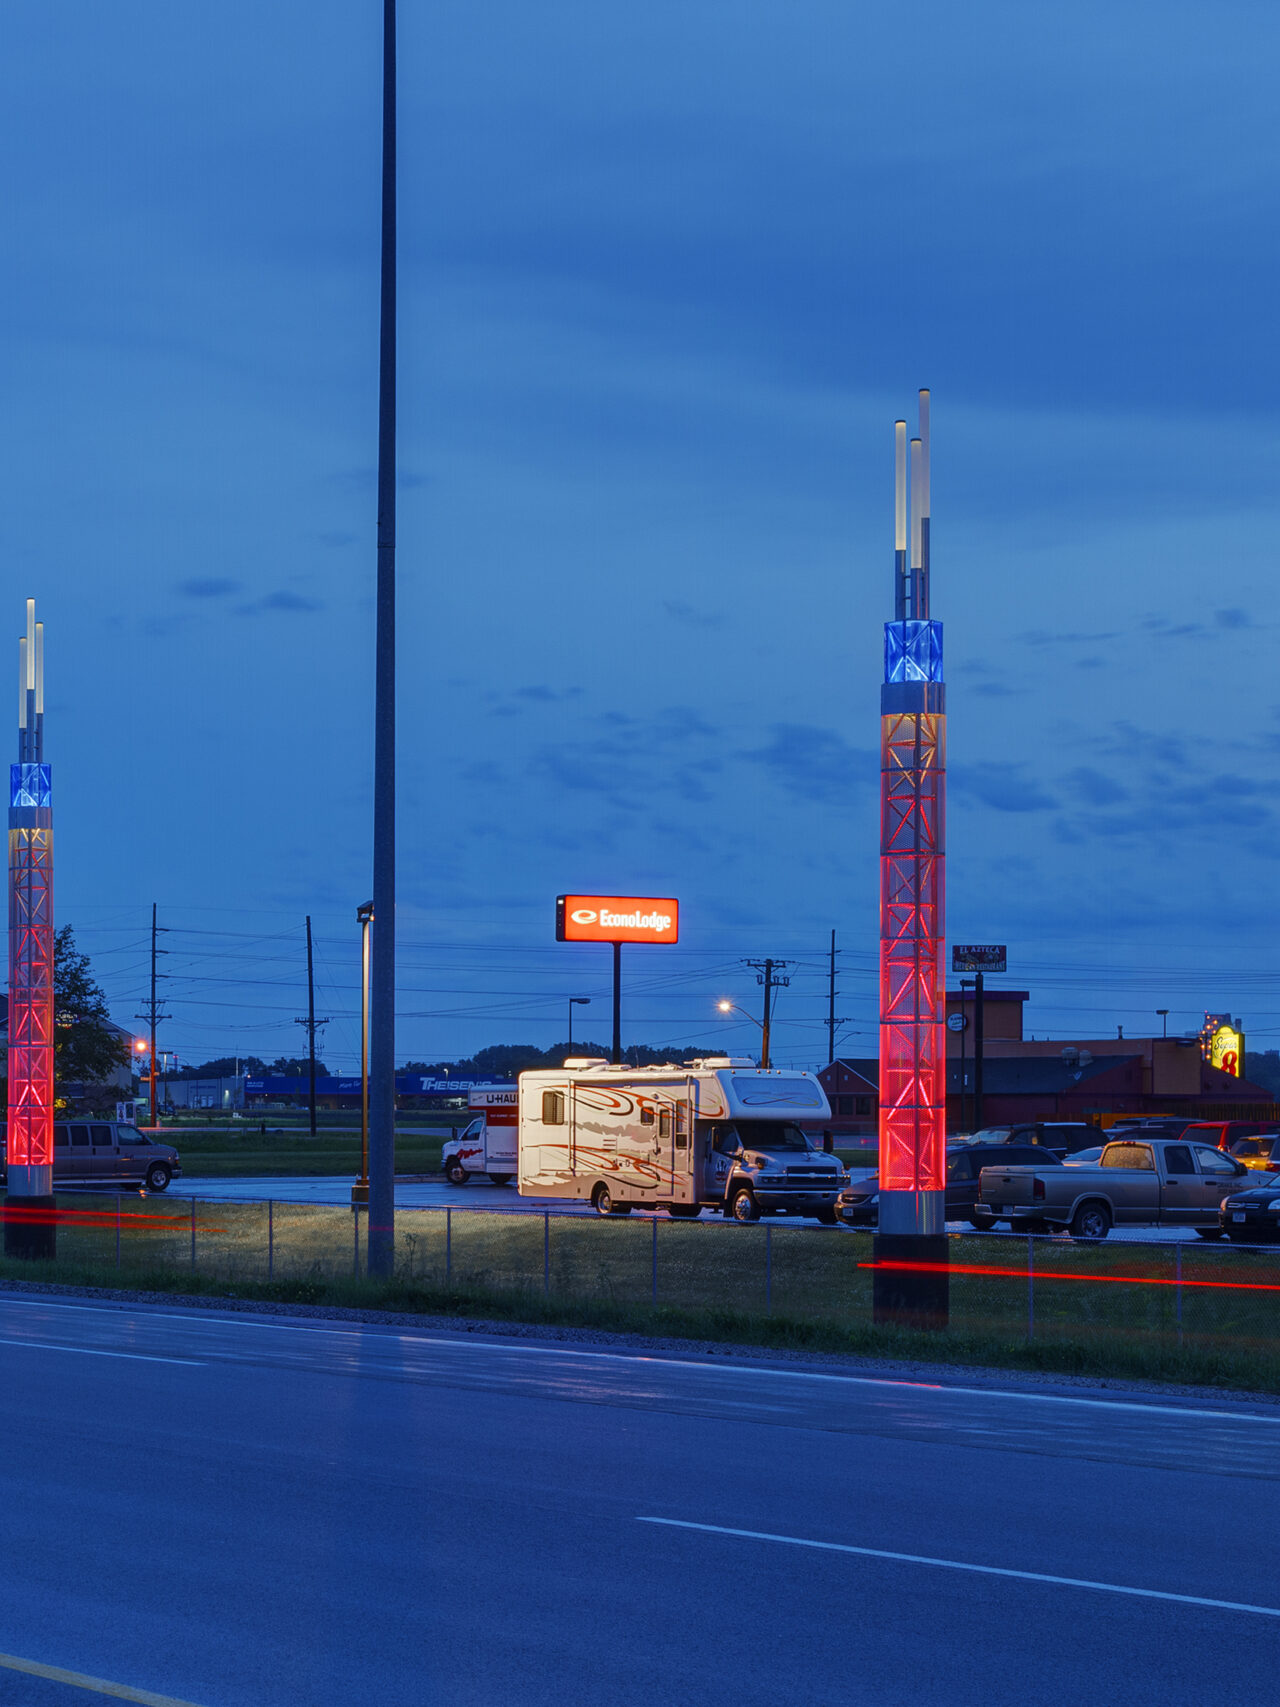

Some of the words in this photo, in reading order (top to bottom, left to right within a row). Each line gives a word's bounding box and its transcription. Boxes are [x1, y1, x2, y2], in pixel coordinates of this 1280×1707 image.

[959, 946, 969, 954] EL
[970, 946, 1000, 954] AZTECA
[1221, 1051, 1237, 1076] 8
